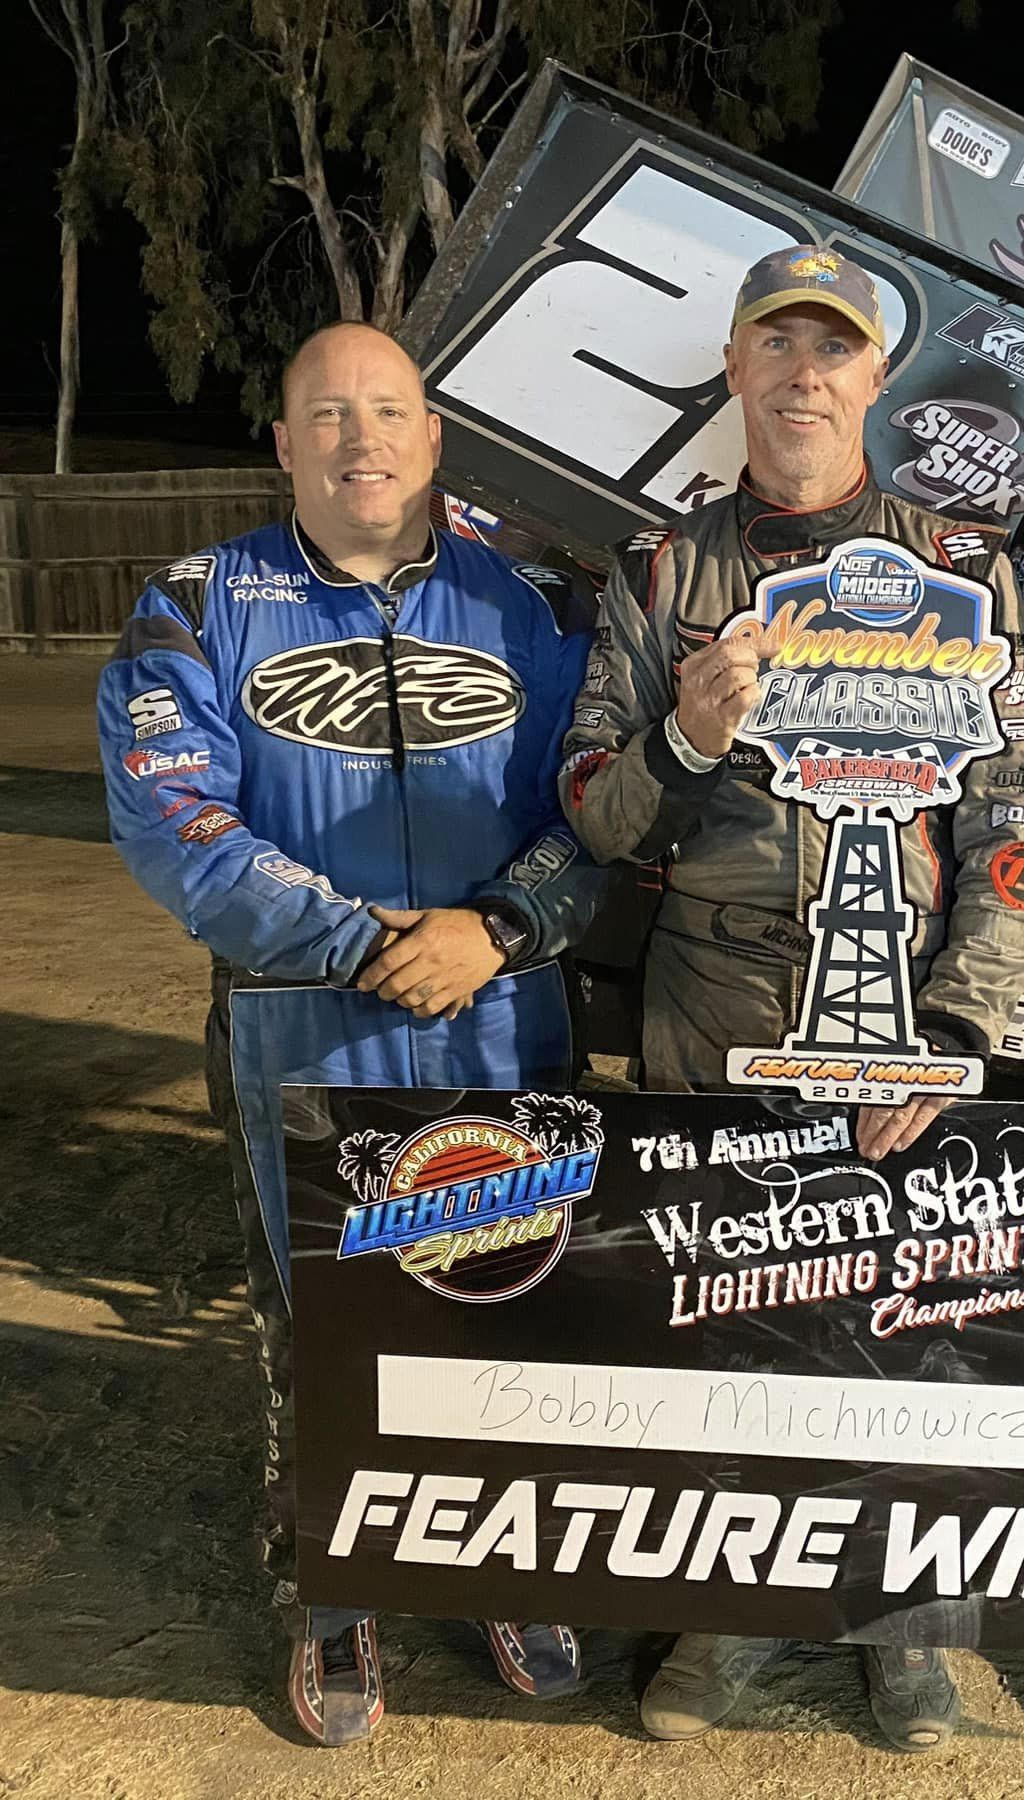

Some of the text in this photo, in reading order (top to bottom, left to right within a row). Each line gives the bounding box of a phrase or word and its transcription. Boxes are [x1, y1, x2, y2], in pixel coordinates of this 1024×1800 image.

[941, 127, 993, 167] DOUG'S
[912, 403, 1019, 474] SUPER
[226, 571, 310, 588] CAL-SUN
[838, 555, 877, 575] NOS
[233, 588, 307, 604] RACING
[840, 576, 917, 597] MIDGET
[755, 599, 1002, 680] November
[137, 717, 178, 740] SIMPSON
[742, 670, 996, 748] CLASSIC
[138, 750, 211, 776] USAC
[730, 752, 763, 766] DESIG
[800, 758, 938, 797] BAKERSFIELD
[823, 779, 909, 791] SPEEDWAY
[744, 1056, 969, 1086] FEATURE WINNER
[813, 1086, 894, 1100] 2023
[394, 1127, 528, 1191] CALIFORNIA
[632, 1116, 853, 1172] 7th Annual
[340, 1150, 600, 1258] LIGHTNING
[640, 1166, 895, 1268] Western
[400, 1209, 563, 1273] Sprints
[669, 1250, 879, 1327] LIGHTNING
[474, 1363, 664, 1448] Bobby
[329, 1470, 861, 1589] FEATURE
